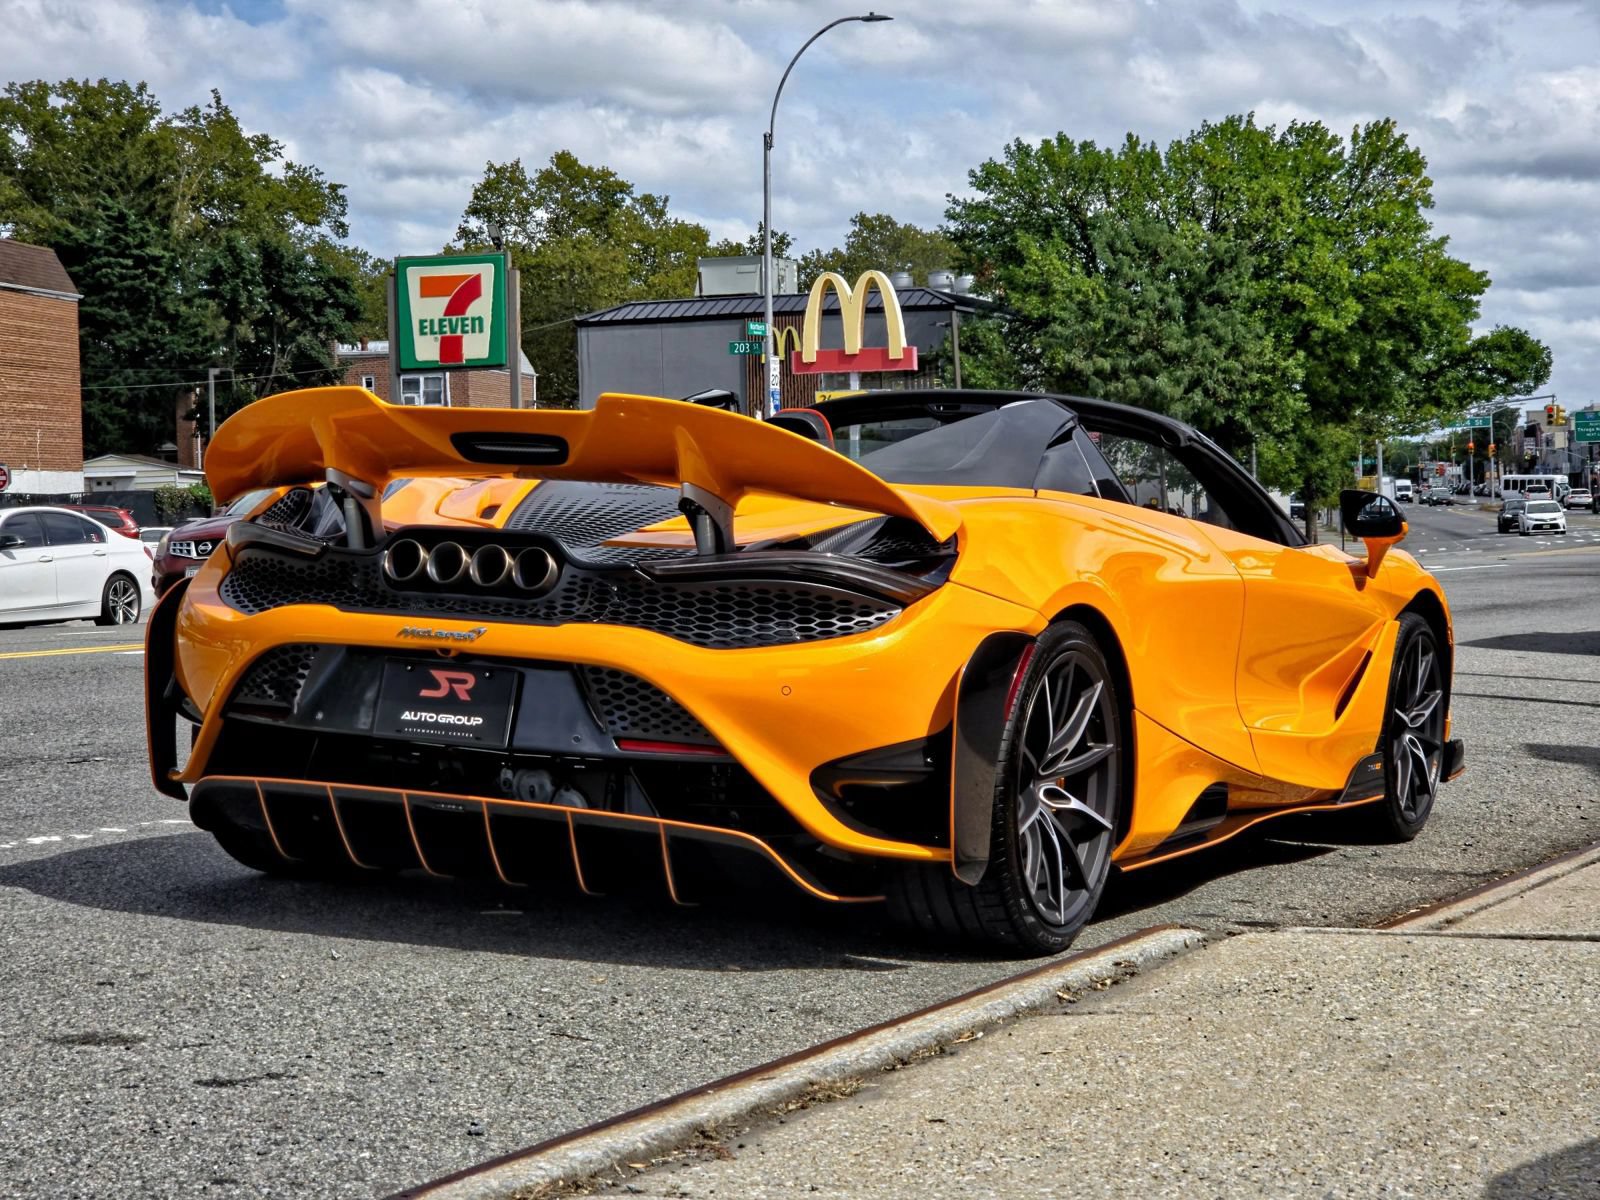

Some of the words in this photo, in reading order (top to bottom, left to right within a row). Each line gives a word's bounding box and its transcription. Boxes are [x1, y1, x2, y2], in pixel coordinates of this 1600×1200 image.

[419, 273, 482, 364] 7
[734, 343, 750, 353] 203
[400, 711, 437, 722] AUTO
[437, 714, 484, 726] GROUP
